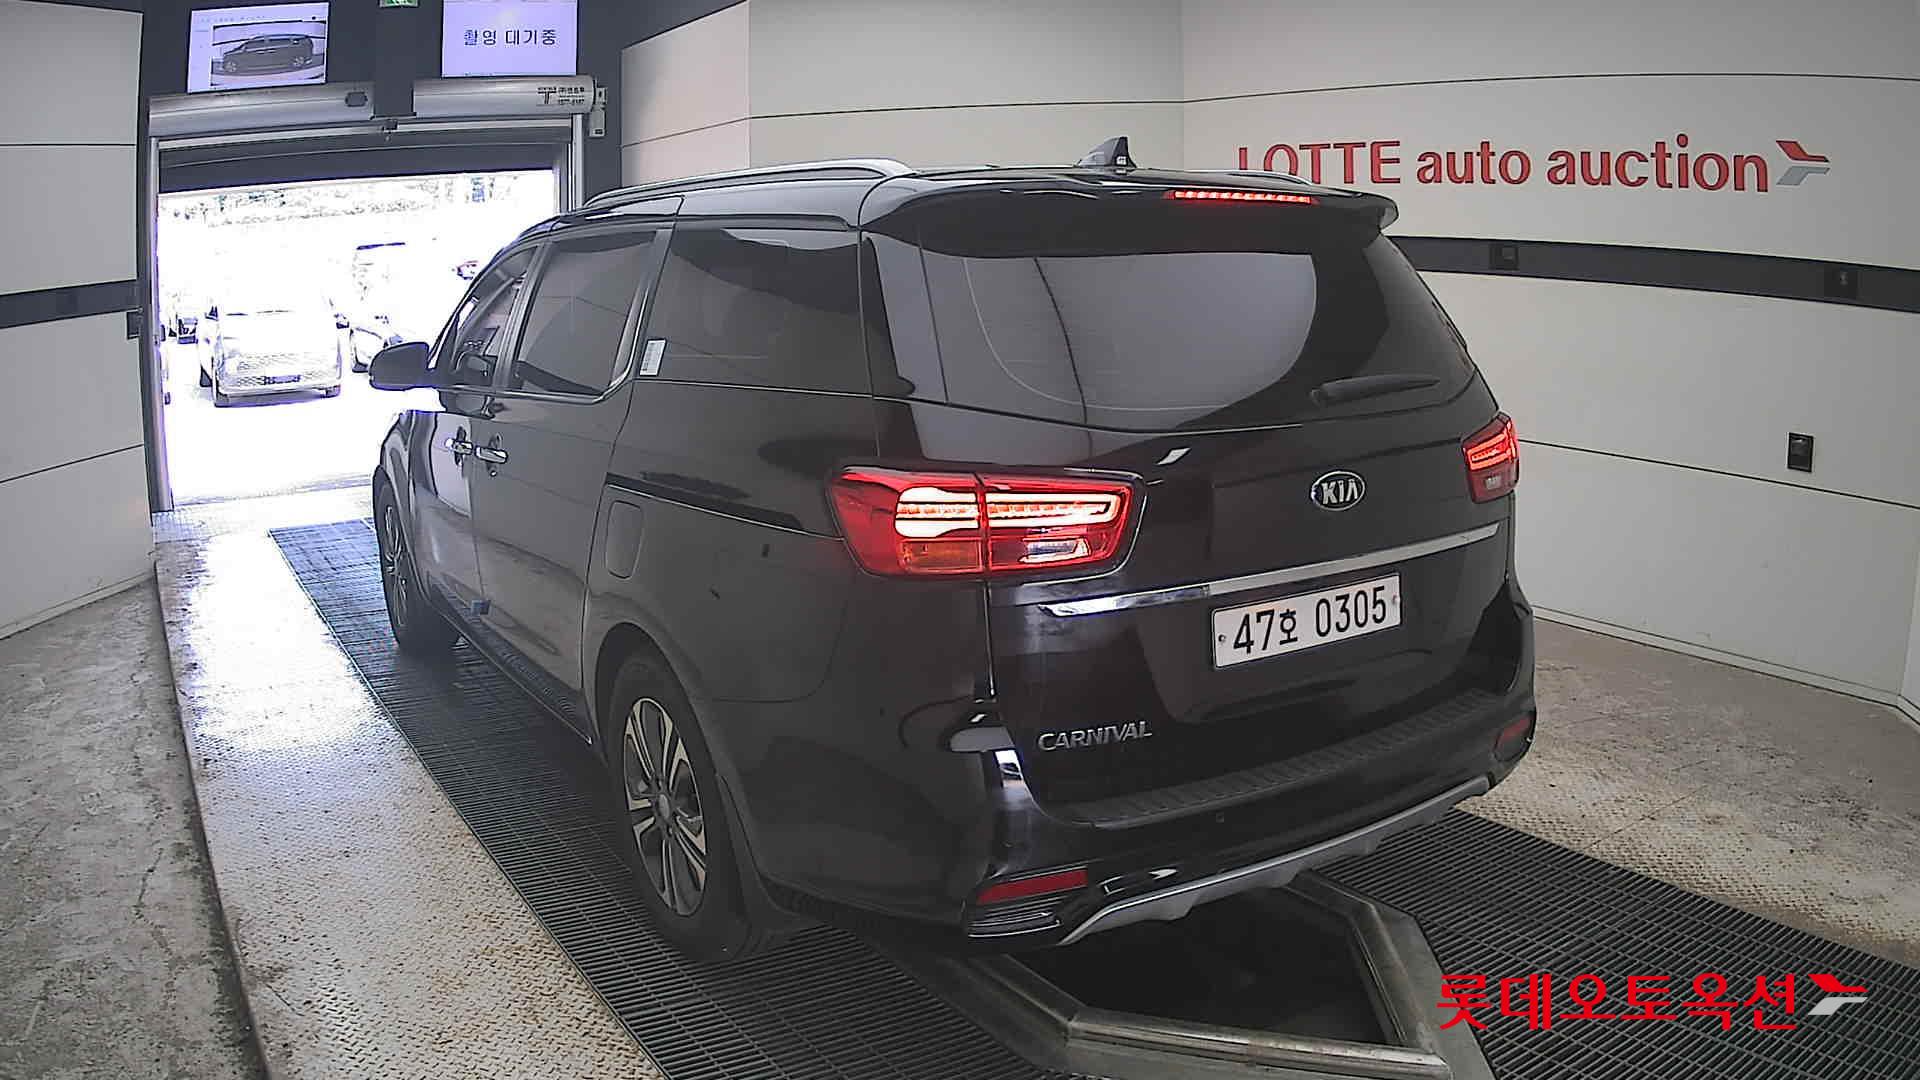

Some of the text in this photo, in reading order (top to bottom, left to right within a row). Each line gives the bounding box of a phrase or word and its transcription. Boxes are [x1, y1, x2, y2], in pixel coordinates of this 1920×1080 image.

[505, 29, 557, 46] 대기중
[1416, 141, 1531, 185] auto
[1546, 133, 1769, 193] auction
[1321, 479, 1358, 505] KIA
[1233, 585, 1386, 654] 47호 0305
[1038, 720, 1153, 751] CARNIVAL
